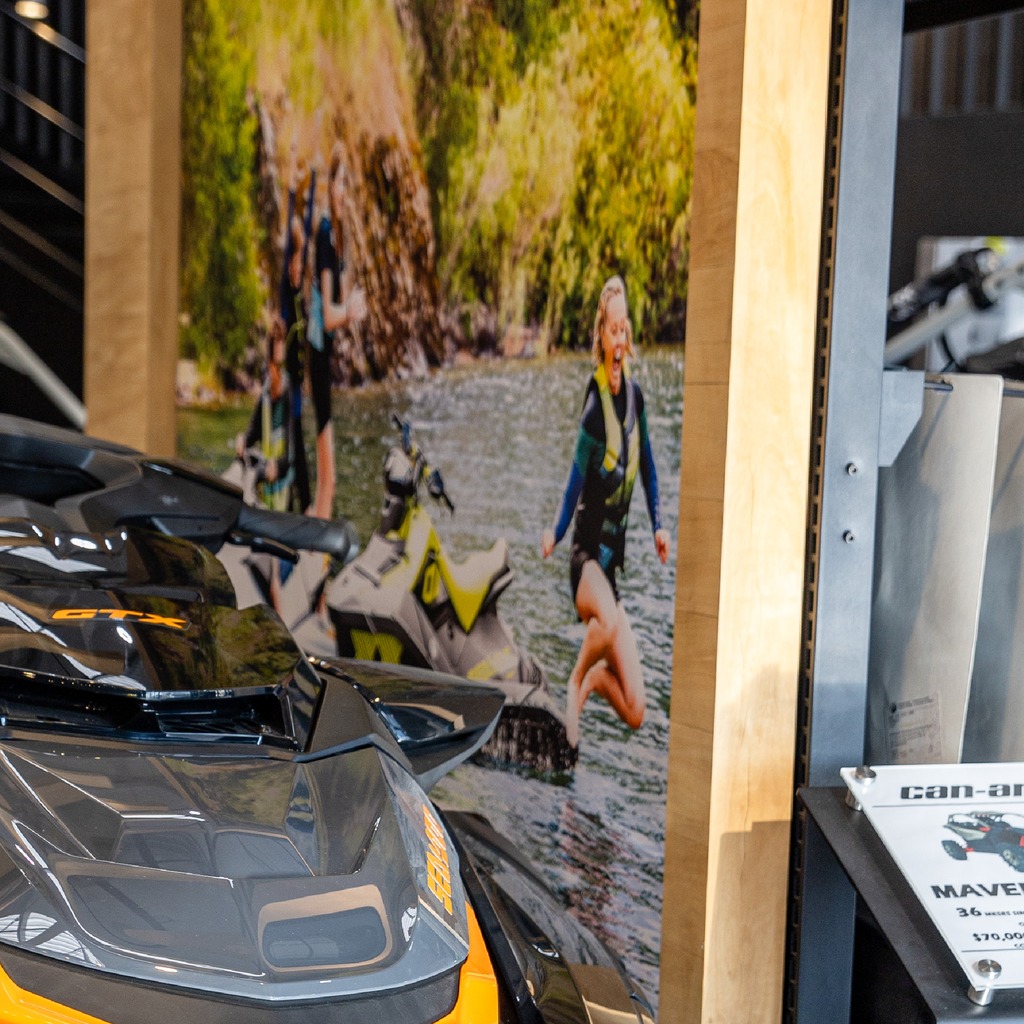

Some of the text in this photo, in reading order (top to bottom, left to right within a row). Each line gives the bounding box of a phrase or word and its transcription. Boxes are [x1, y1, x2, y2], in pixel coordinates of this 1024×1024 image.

[51, 608, 187, 629] GTX
[956, 907, 983, 917] 36
[972, 932, 1024, 942] $70,00
